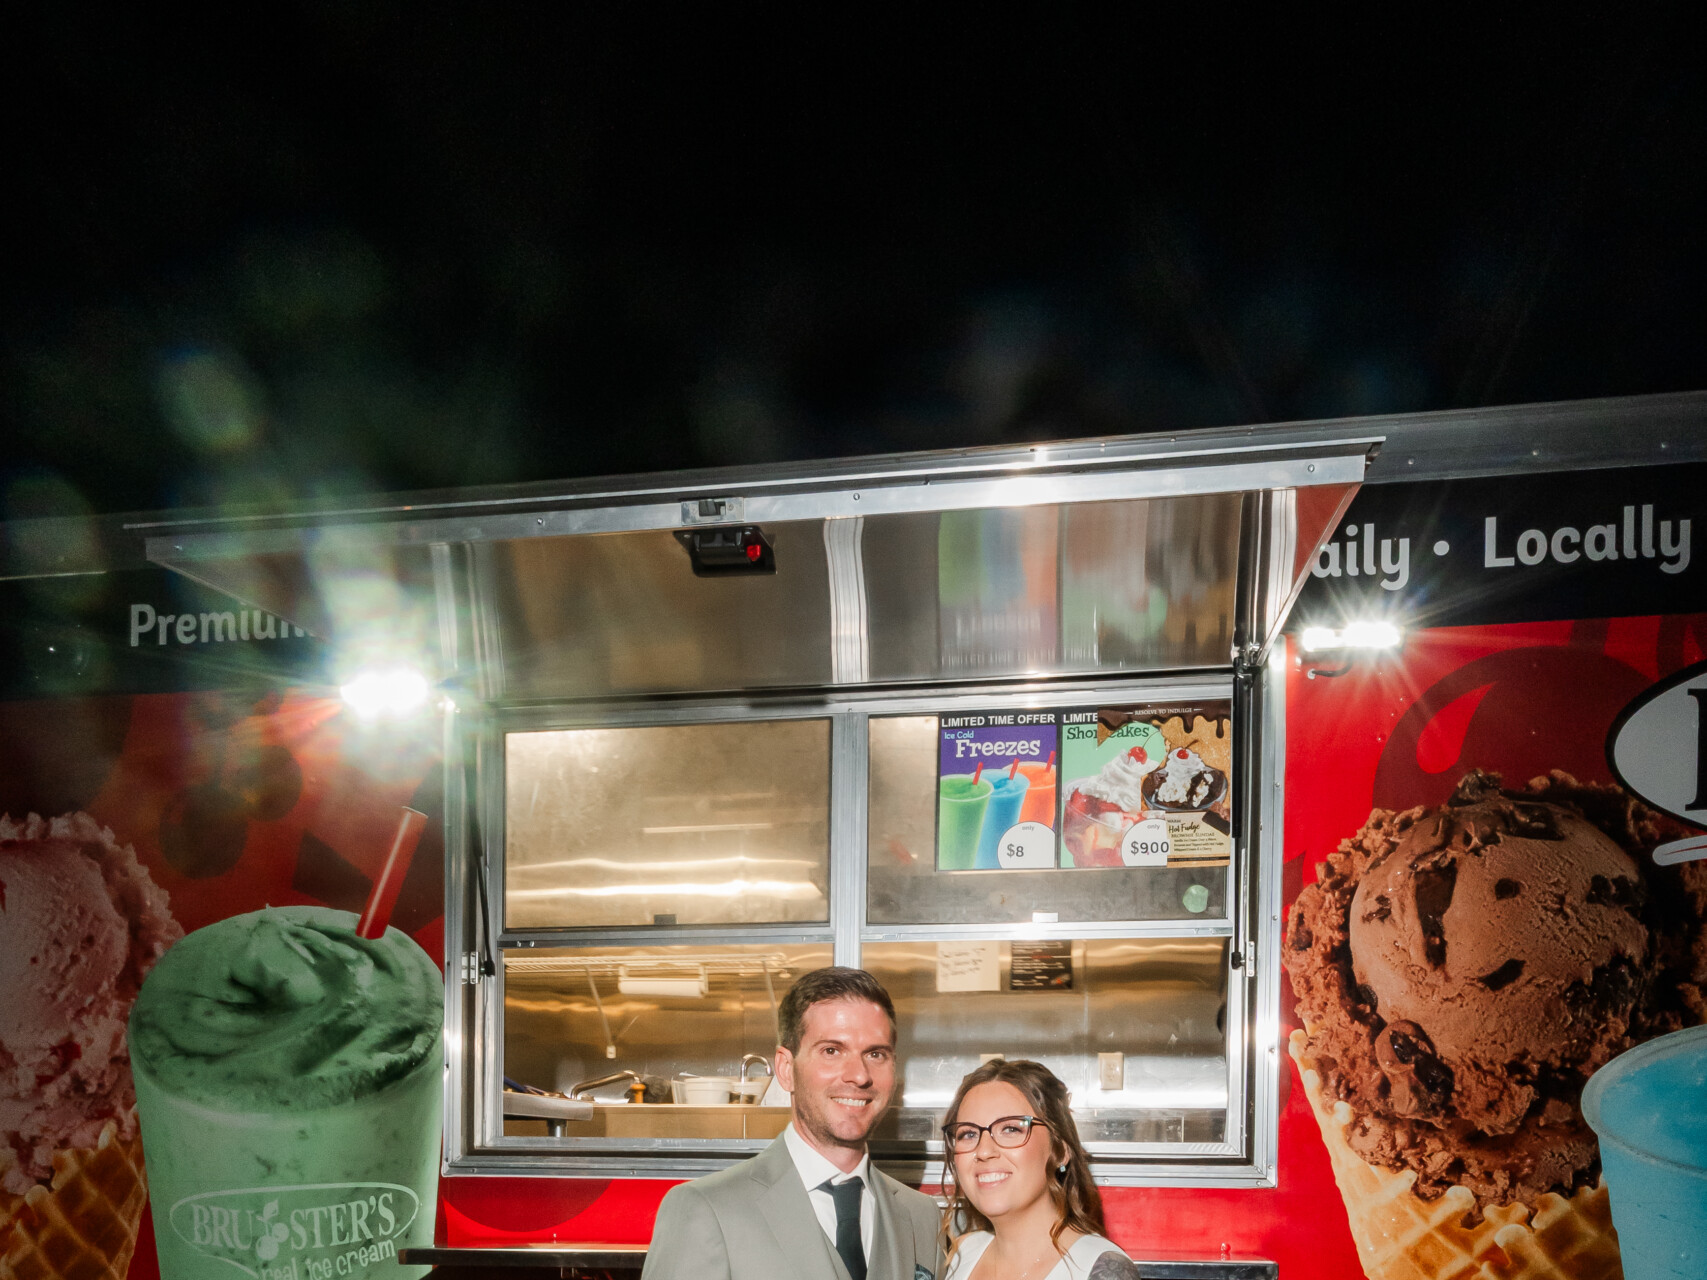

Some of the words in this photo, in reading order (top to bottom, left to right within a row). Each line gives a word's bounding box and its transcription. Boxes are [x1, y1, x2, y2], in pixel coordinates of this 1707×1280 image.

[1312, 523, 1411, 591] aily
[1484, 504, 1692, 575] Locally
[941, 716, 985, 727] LIMITED
[988, 715, 1015, 725] TIME
[1017, 713, 1056, 724] OFFER
[1062, 712, 1098, 723] LIMITE
[957, 730, 974, 739] Cold
[1066, 725, 1150, 740] Shoakes
[955, 739, 1041, 758] Freezes
[1168, 824, 1180, 833] Hot
[1180, 821, 1200, 833] Fudge
[1006, 843, 1024, 858] $8
[335, 1239, 397, 1277] cream
